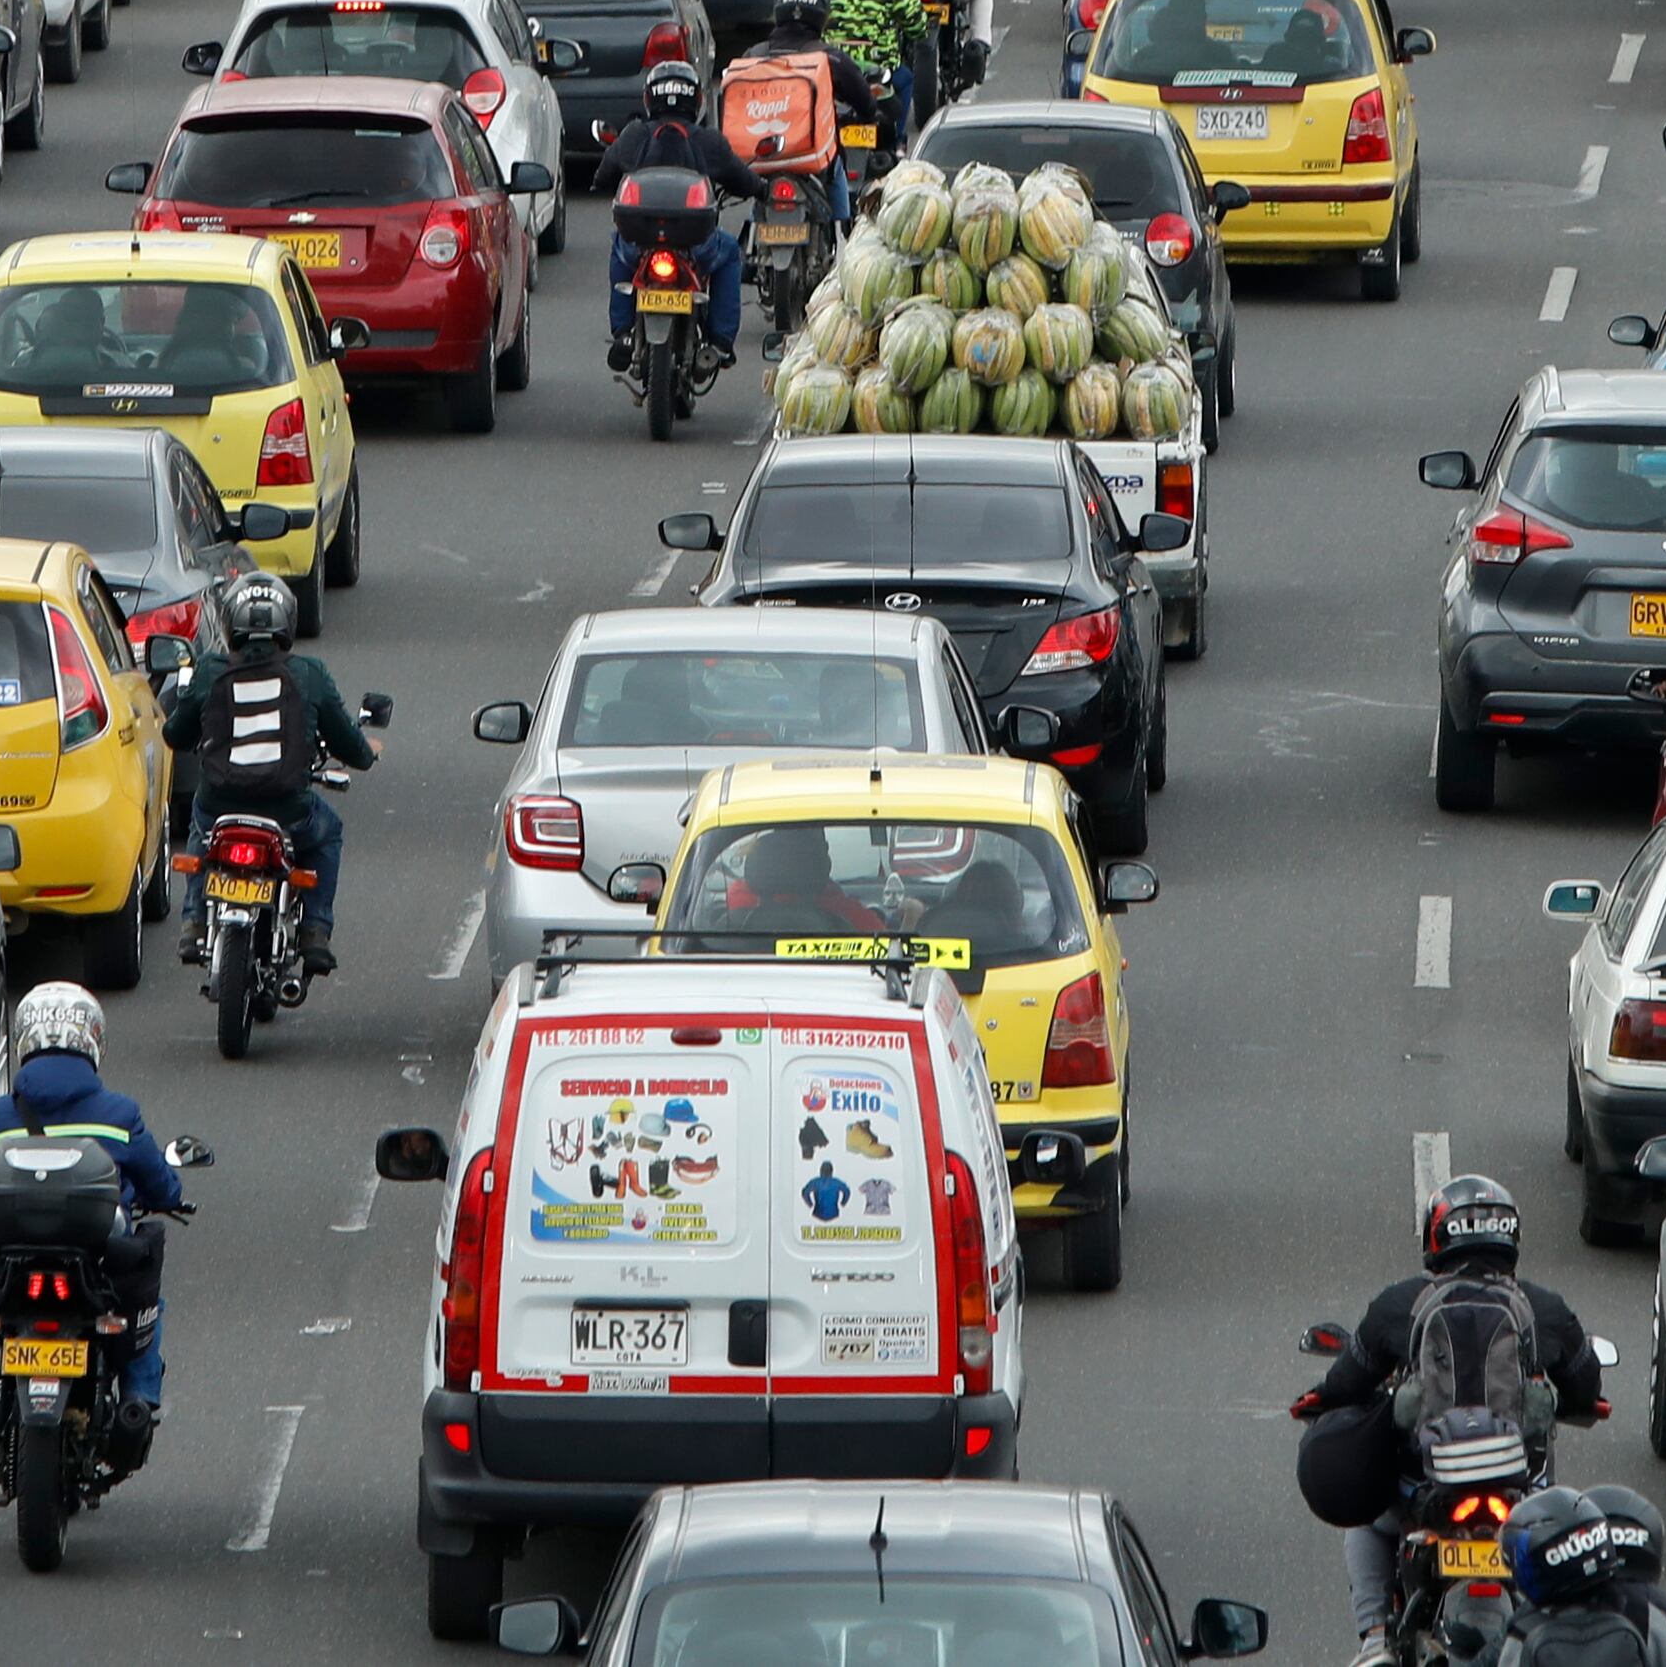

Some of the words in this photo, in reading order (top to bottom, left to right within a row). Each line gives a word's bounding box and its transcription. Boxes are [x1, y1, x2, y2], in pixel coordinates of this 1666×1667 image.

[745, 95, 791, 120] Rappi
[23, 1006, 85, 1026] SNK65E
[569, 1029, 597, 1045] 261
[601, 1028, 622, 1044] 88
[625, 1028, 646, 1044] 52
[561, 1079, 632, 1097] SERVICIO
[634, 1079, 646, 1096] A
[647, 1079, 729, 1096] DOMICILIO
[829, 1078, 883, 1091] Dotaciones
[832, 1090, 882, 1113] Exito
[575, 1318, 684, 1350] WLR·367
[825, 1327, 876, 1338] MARQUE
[883, 1327, 926, 1338] GRATIS
[6, 1345, 85, 1367] SNK·65E
[616, 1352, 641, 1362] COTA
[827, 1342, 871, 1355] #767
